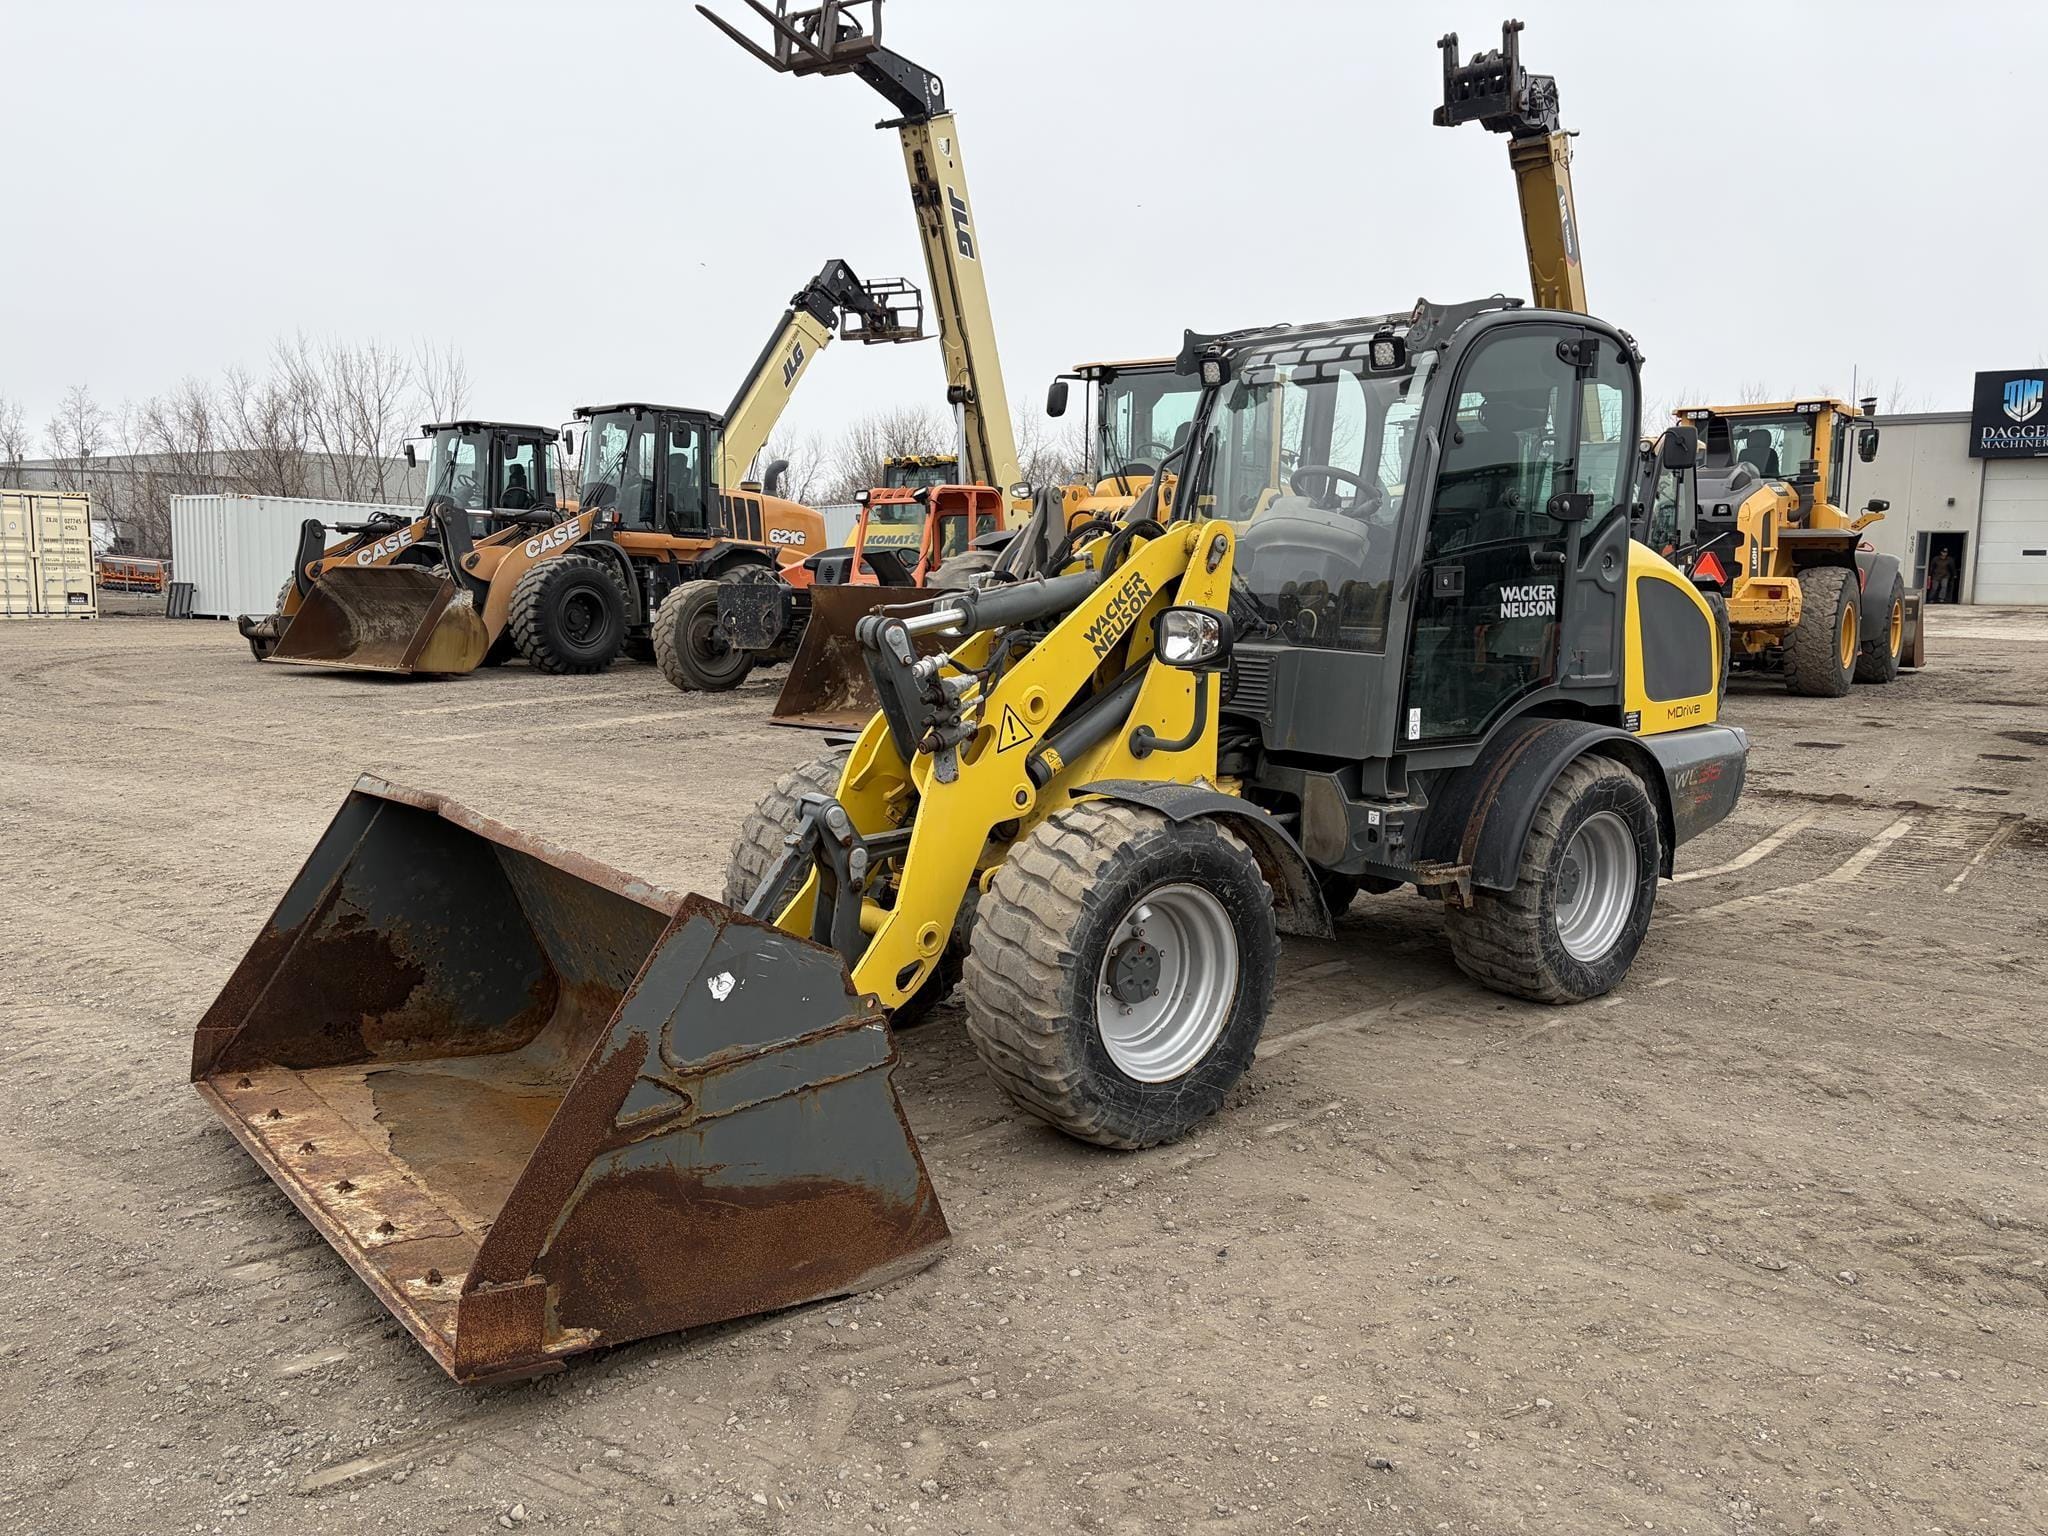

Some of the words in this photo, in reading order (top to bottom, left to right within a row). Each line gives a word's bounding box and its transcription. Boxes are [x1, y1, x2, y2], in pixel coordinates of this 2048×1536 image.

[947, 185, 975, 261] JLG
[782, 340, 805, 389] JLG
[1981, 425, 2048, 439] DAGGE
[356, 528, 413, 566] CASE
[525, 519, 581, 558] CASE
[768, 528, 806, 546] 621G
[866, 533, 922, 545] KOMATS
[1083, 571, 1144, 643] WACKER
[1500, 585, 1556, 602] WACKER
[1093, 582, 1153, 659] NEUSON
[1500, 600, 1556, 619] NEUSON
[1667, 704, 1701, 720] MDrive
